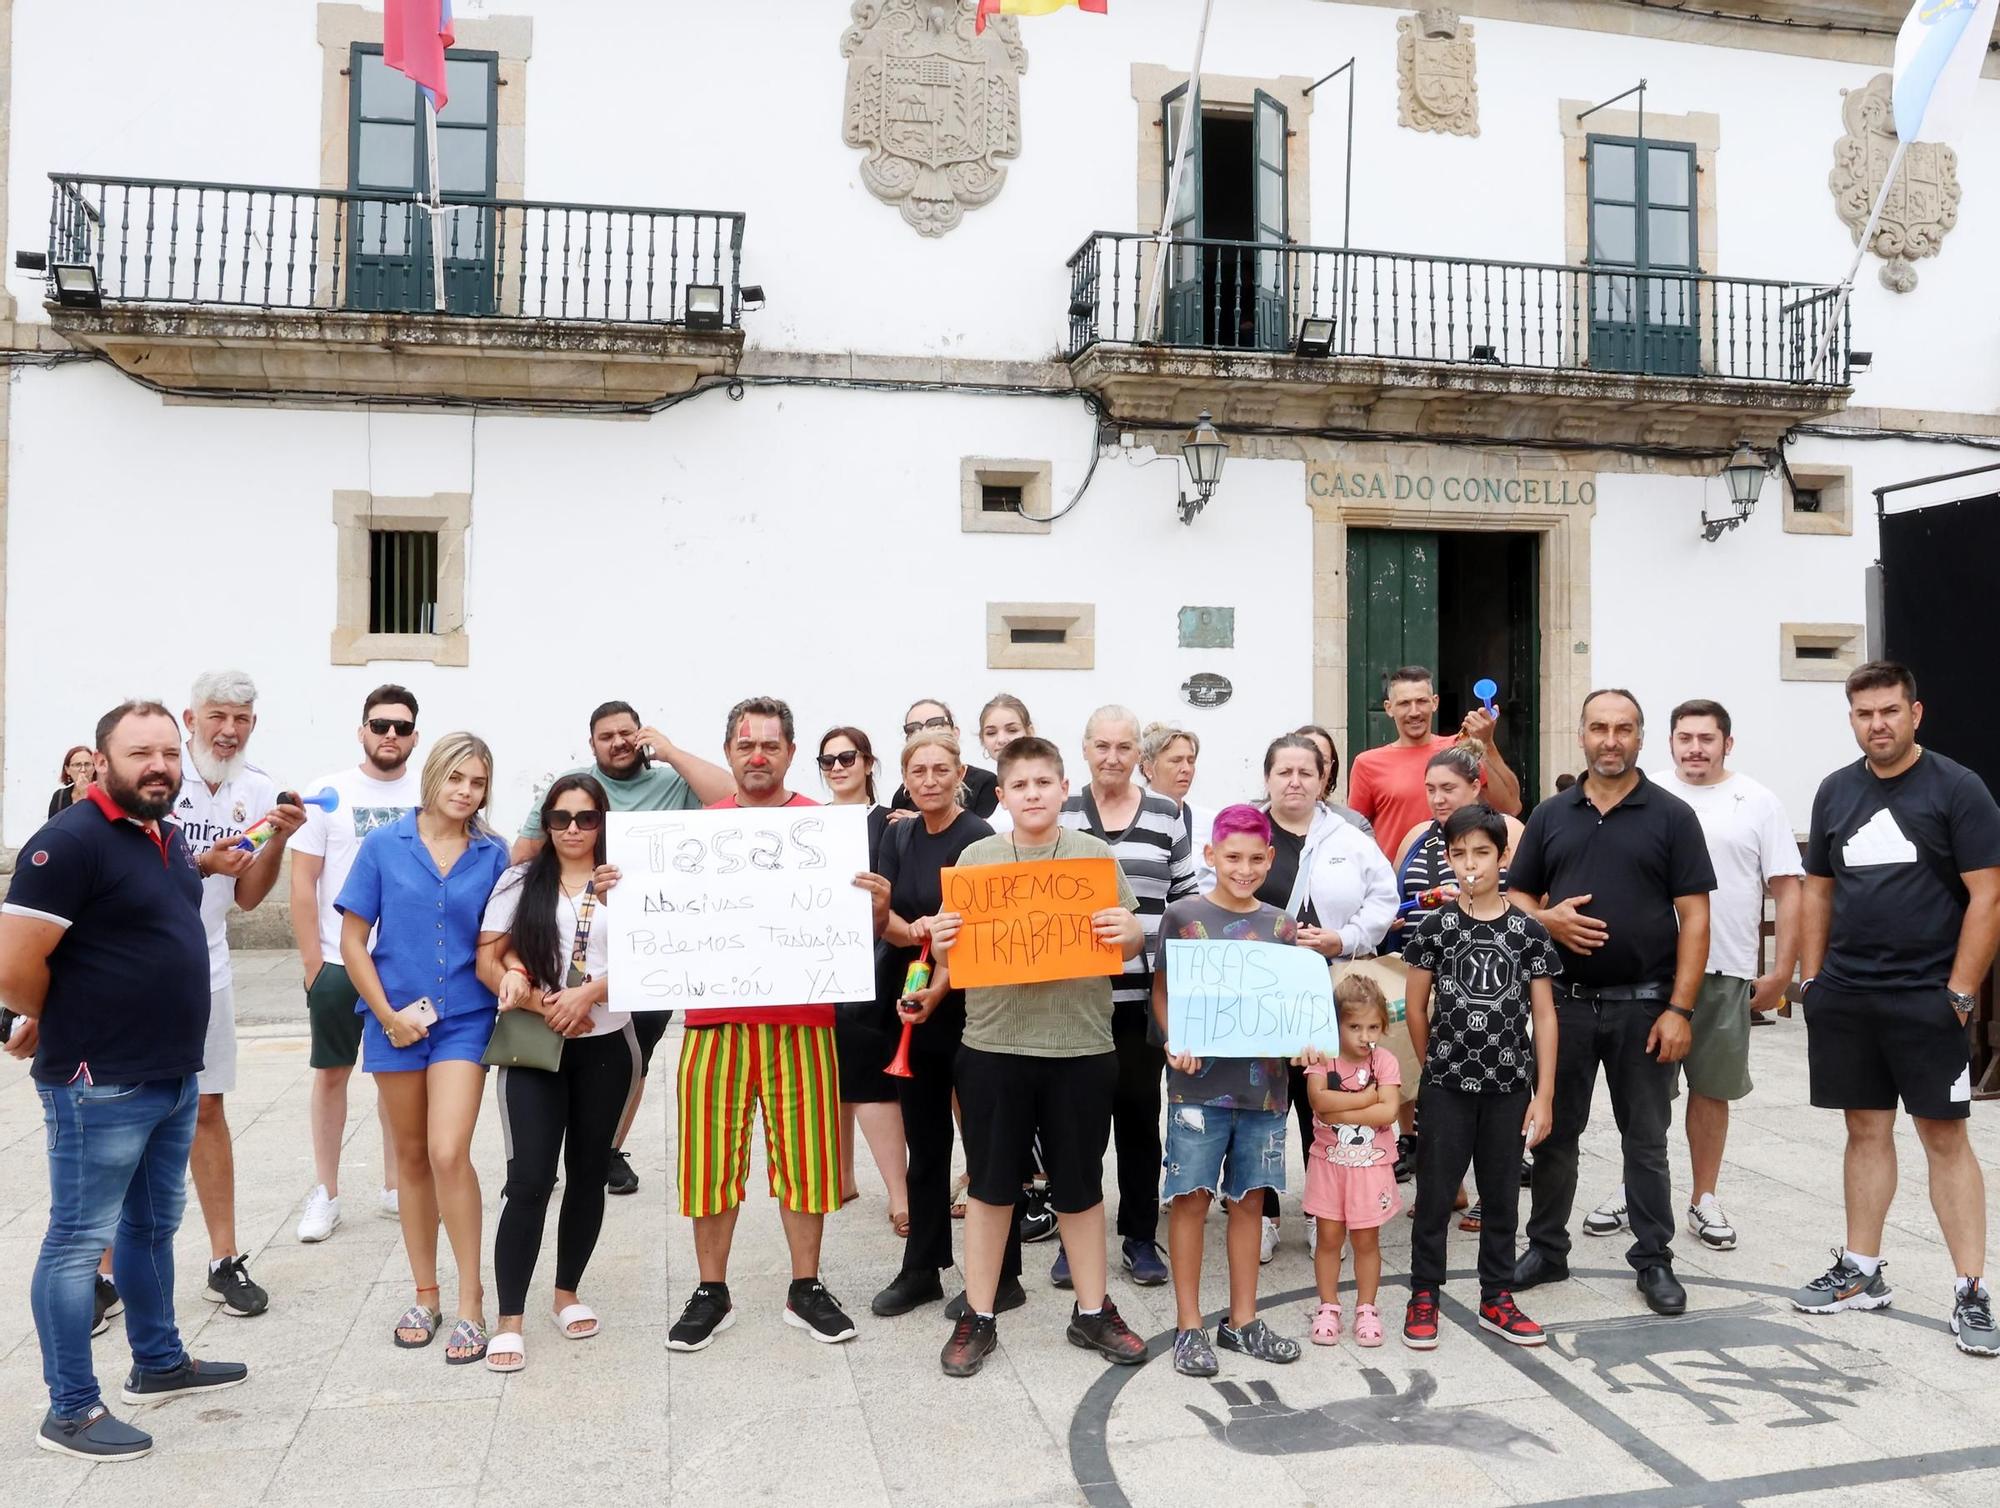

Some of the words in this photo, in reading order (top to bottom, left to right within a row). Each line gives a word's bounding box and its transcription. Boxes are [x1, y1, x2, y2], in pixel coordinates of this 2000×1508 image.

[1310, 472, 1387, 498] CASA
[1395, 474, 1435, 500] DO
[1444, 477, 1595, 505] CONCELLO
[791, 884, 832, 912] NO
[950, 873, 1095, 915] QUEREMOS
[1170, 942, 1278, 990] TASAS
